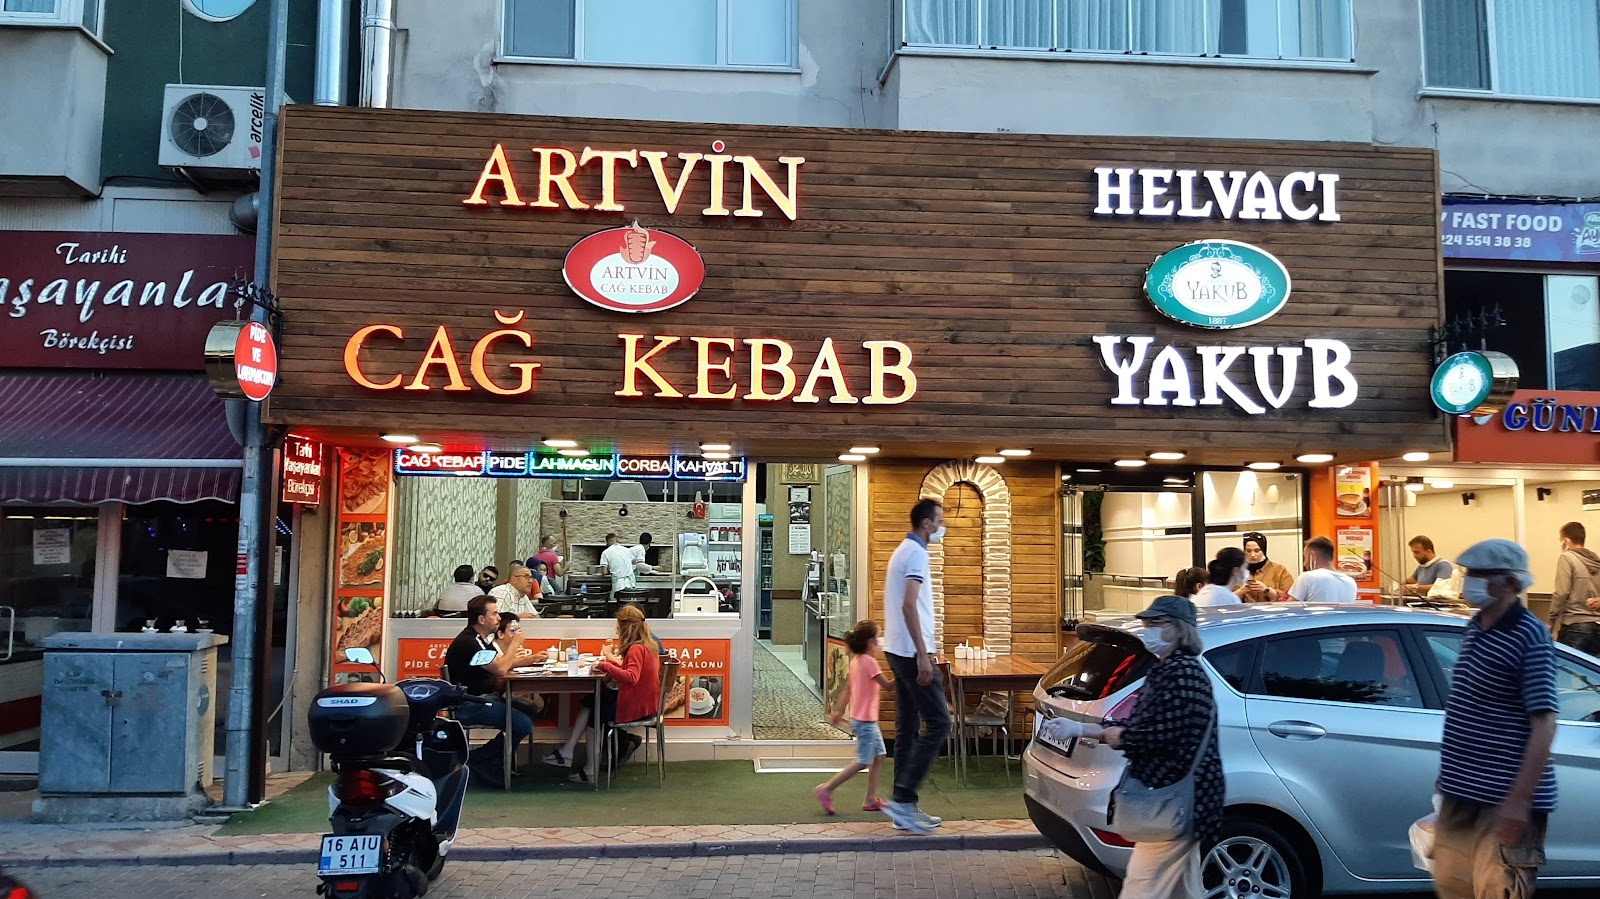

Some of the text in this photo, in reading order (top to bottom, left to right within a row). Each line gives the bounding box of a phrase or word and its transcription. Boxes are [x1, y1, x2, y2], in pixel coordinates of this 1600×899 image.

[463, 140, 806, 221] ARTVİN
[1093, 167, 1341, 222] HELVACI
[1452, 212, 1501, 230] FAST
[1506, 214, 1563, 232] FOOD
[1466, 235, 1491, 246] 554
[1494, 236, 1511, 247] 38
[1514, 237, 1531, 248] 38
[56, 242, 127, 265] Tarihi
[601, 264, 669, 281] ARTVİN
[600, 282, 669, 295] CAĞ KEBAB
[1186, 281, 1248, 303] YAKUB
[40, 329, 133, 354] Börekçisi
[252, 347, 261, 363] VE
[344, 309, 917, 405] CAĞ KEBAB
[1092, 335, 1359, 415] YAKUB
[428, 647, 702, 660] CA BAP
[404, 660, 724, 669] PİDE SALONU
[327, 837, 379, 851] 16 AIU
[339, 854, 365, 868] 511
